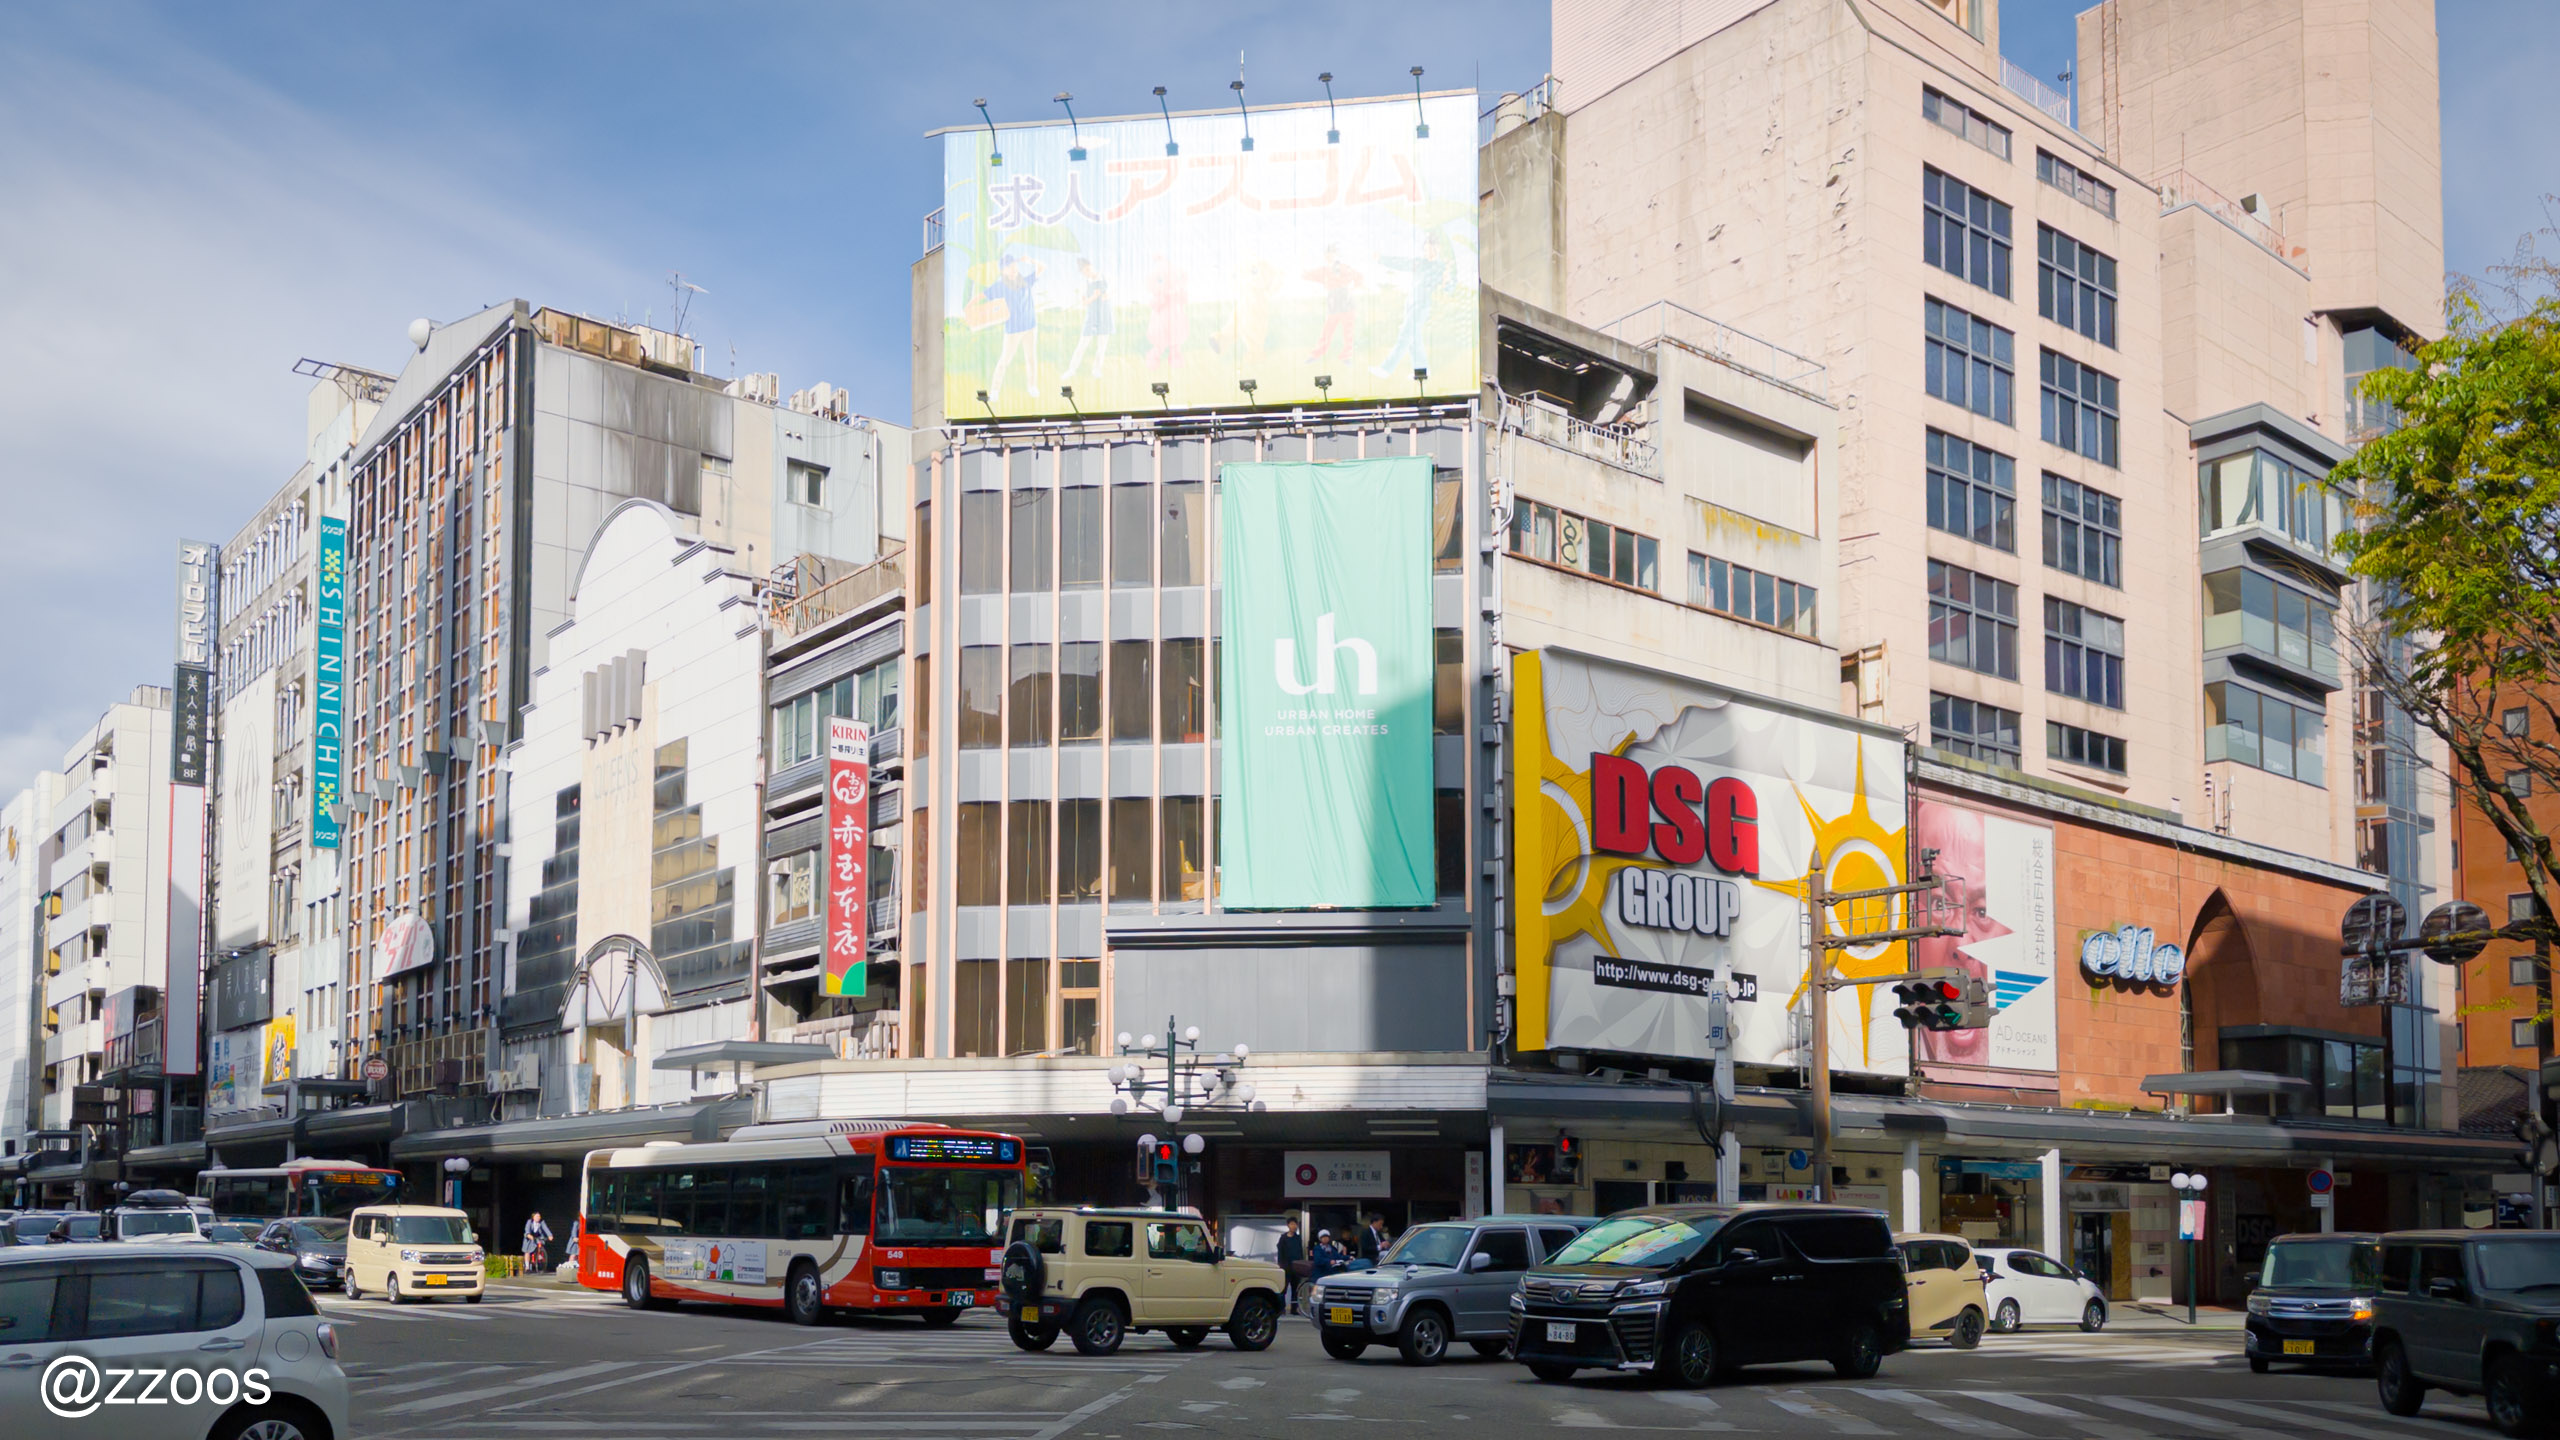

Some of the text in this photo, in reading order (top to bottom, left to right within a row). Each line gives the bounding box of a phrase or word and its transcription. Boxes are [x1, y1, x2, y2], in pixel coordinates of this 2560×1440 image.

[988, 145, 1424, 229] 求人 アスコム
[182, 544, 207, 664] オーロラビル
[1275, 611, 1378, 696] uh
[317, 585, 342, 778] SHINNICHI
[1277, 709, 1376, 720] URBAN HOME
[832, 724, 867, 742] KIRIN
[1264, 724, 1389, 736] URBAN CREATES
[183, 768, 197, 778] 8F
[1591, 751, 1760, 880] DSG
[315, 830, 337, 841] シンニチ
[1619, 865, 1741, 937] GROUP
[1711, 990, 1723, 1040] 片町
[1995, 1024, 2048, 1045] AD OCEANS
[1776, 1188, 1803, 1200] LAND
[887, 1250, 904, 1259] 549
